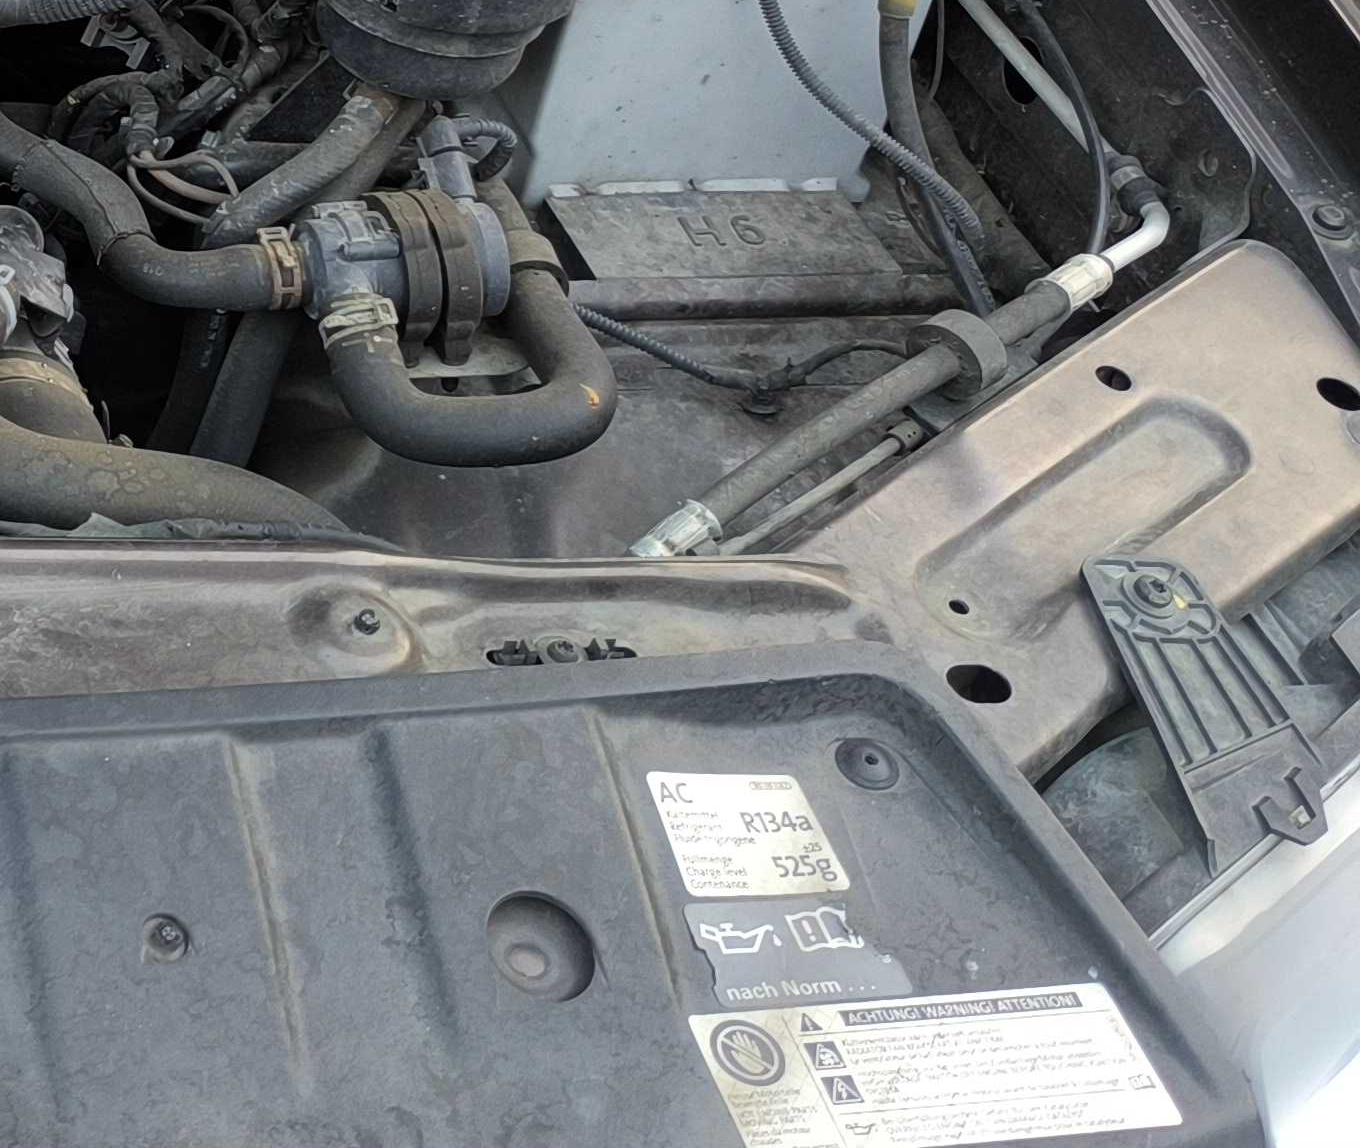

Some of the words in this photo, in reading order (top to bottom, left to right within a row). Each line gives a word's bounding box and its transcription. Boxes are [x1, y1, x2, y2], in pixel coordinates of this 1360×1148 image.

[660, 781, 693, 803] AC
[740, 811, 813, 833] R134a
[685, 866, 722, 879] Charge
[771, 855, 838, 882] 525g
[690, 879, 750, 890] Contenance
[726, 980, 778, 1001] nach
[780, 977, 842, 997] Norm
[848, 1007, 923, 1026] ACHTUNG!
[924, 1001, 996, 1020] WARNING!
[998, 995, 1079, 1015] ATTENTION!
